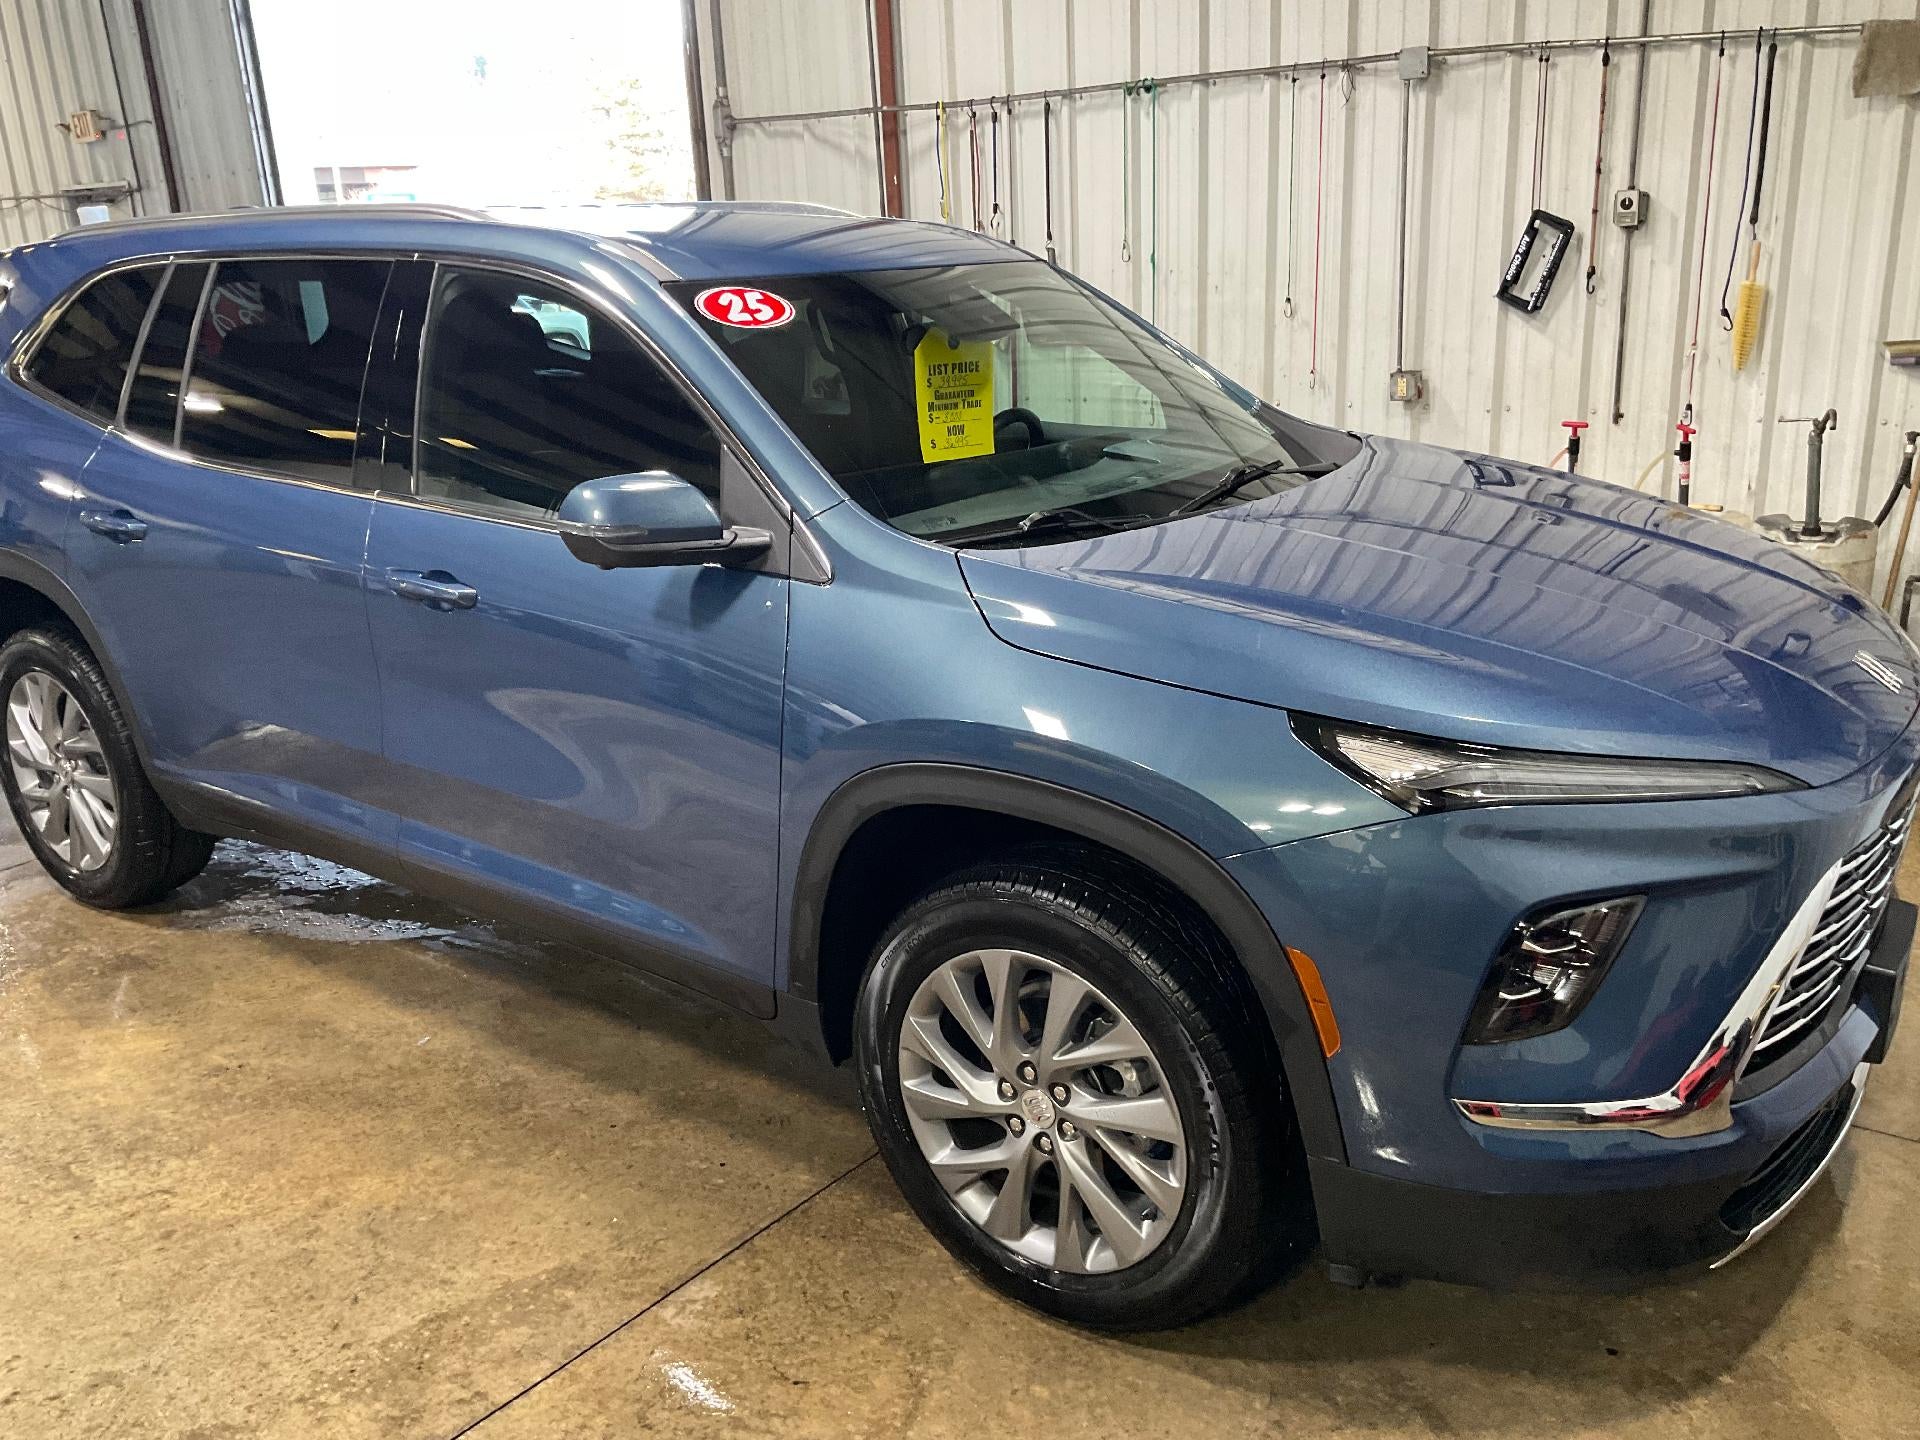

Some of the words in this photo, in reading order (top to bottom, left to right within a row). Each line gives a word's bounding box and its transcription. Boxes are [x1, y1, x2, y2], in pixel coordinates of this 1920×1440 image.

[1518, 234, 1530, 253] Auto
[1505, 253, 1521, 281] Choice
[718, 292, 774, 322] 25
[928, 363, 949, 376] LIST
[951, 360, 980, 374] PRICE
[926, 377, 932, 388] $
[946, 424, 965, 437] NOW
[930, 439, 937, 449] $
